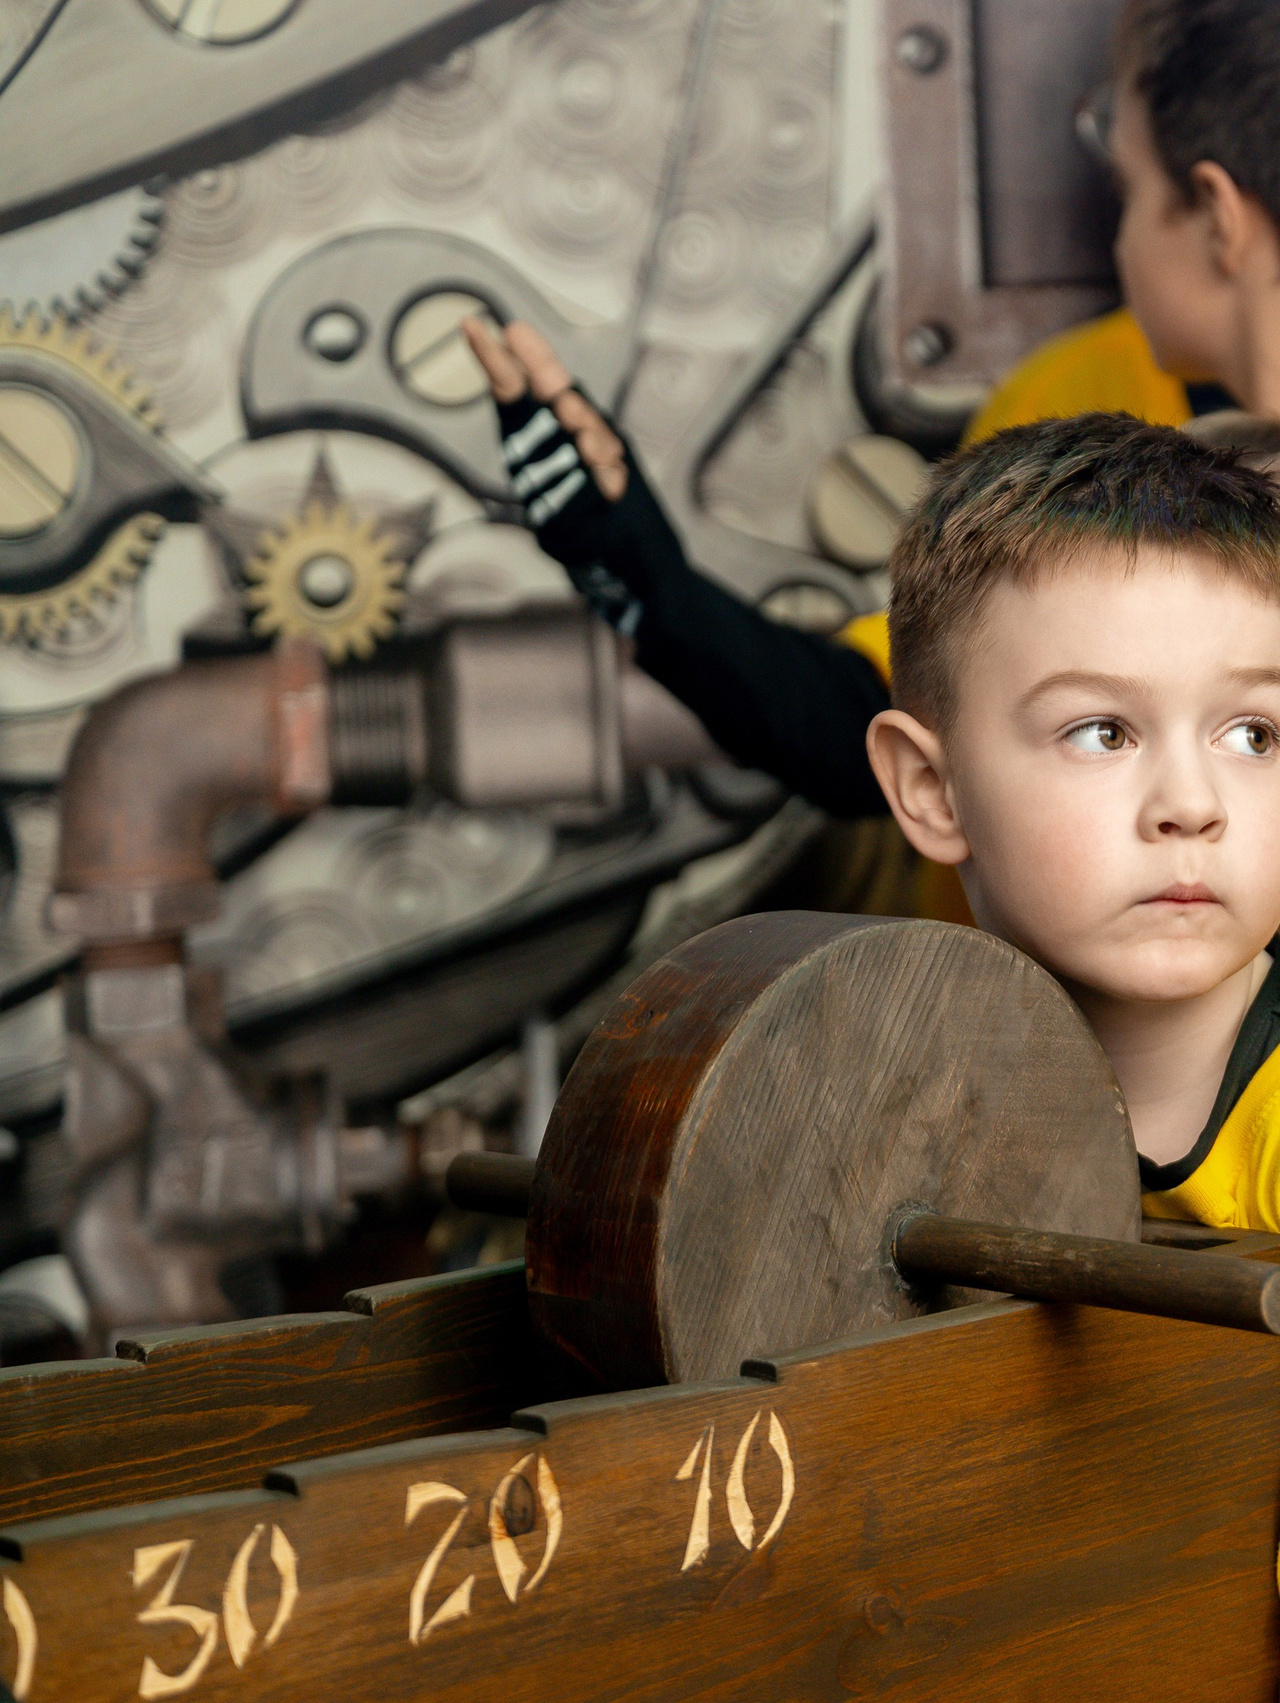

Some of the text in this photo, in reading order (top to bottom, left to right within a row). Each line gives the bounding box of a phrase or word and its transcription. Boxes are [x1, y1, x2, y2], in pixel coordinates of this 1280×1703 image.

[131, 1523, 300, 1701] 30
[405, 1452, 563, 1646] 20
[675, 1409, 796, 1574] 10
